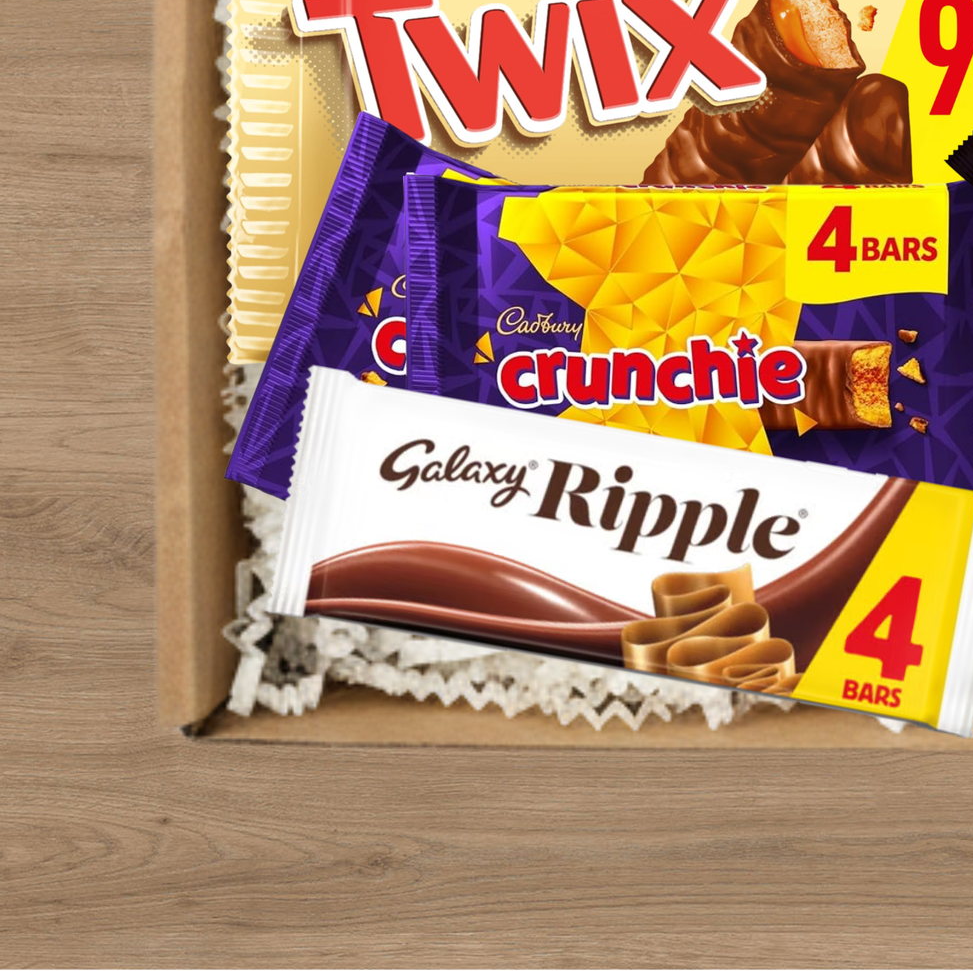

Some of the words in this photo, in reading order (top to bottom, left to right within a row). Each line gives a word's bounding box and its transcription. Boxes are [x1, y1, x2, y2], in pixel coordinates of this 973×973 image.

[806, 205, 858, 272] 4
[862, 237, 938, 261] BARS
[496, 305, 584, 341] Cadbury
[499, 330, 804, 407] crunchie
[379, 439, 532, 508] Galaxy
[531, 459, 801, 563] Ripple
[844, 575, 924, 681] 4
[842, 679, 902, 707] BARS
